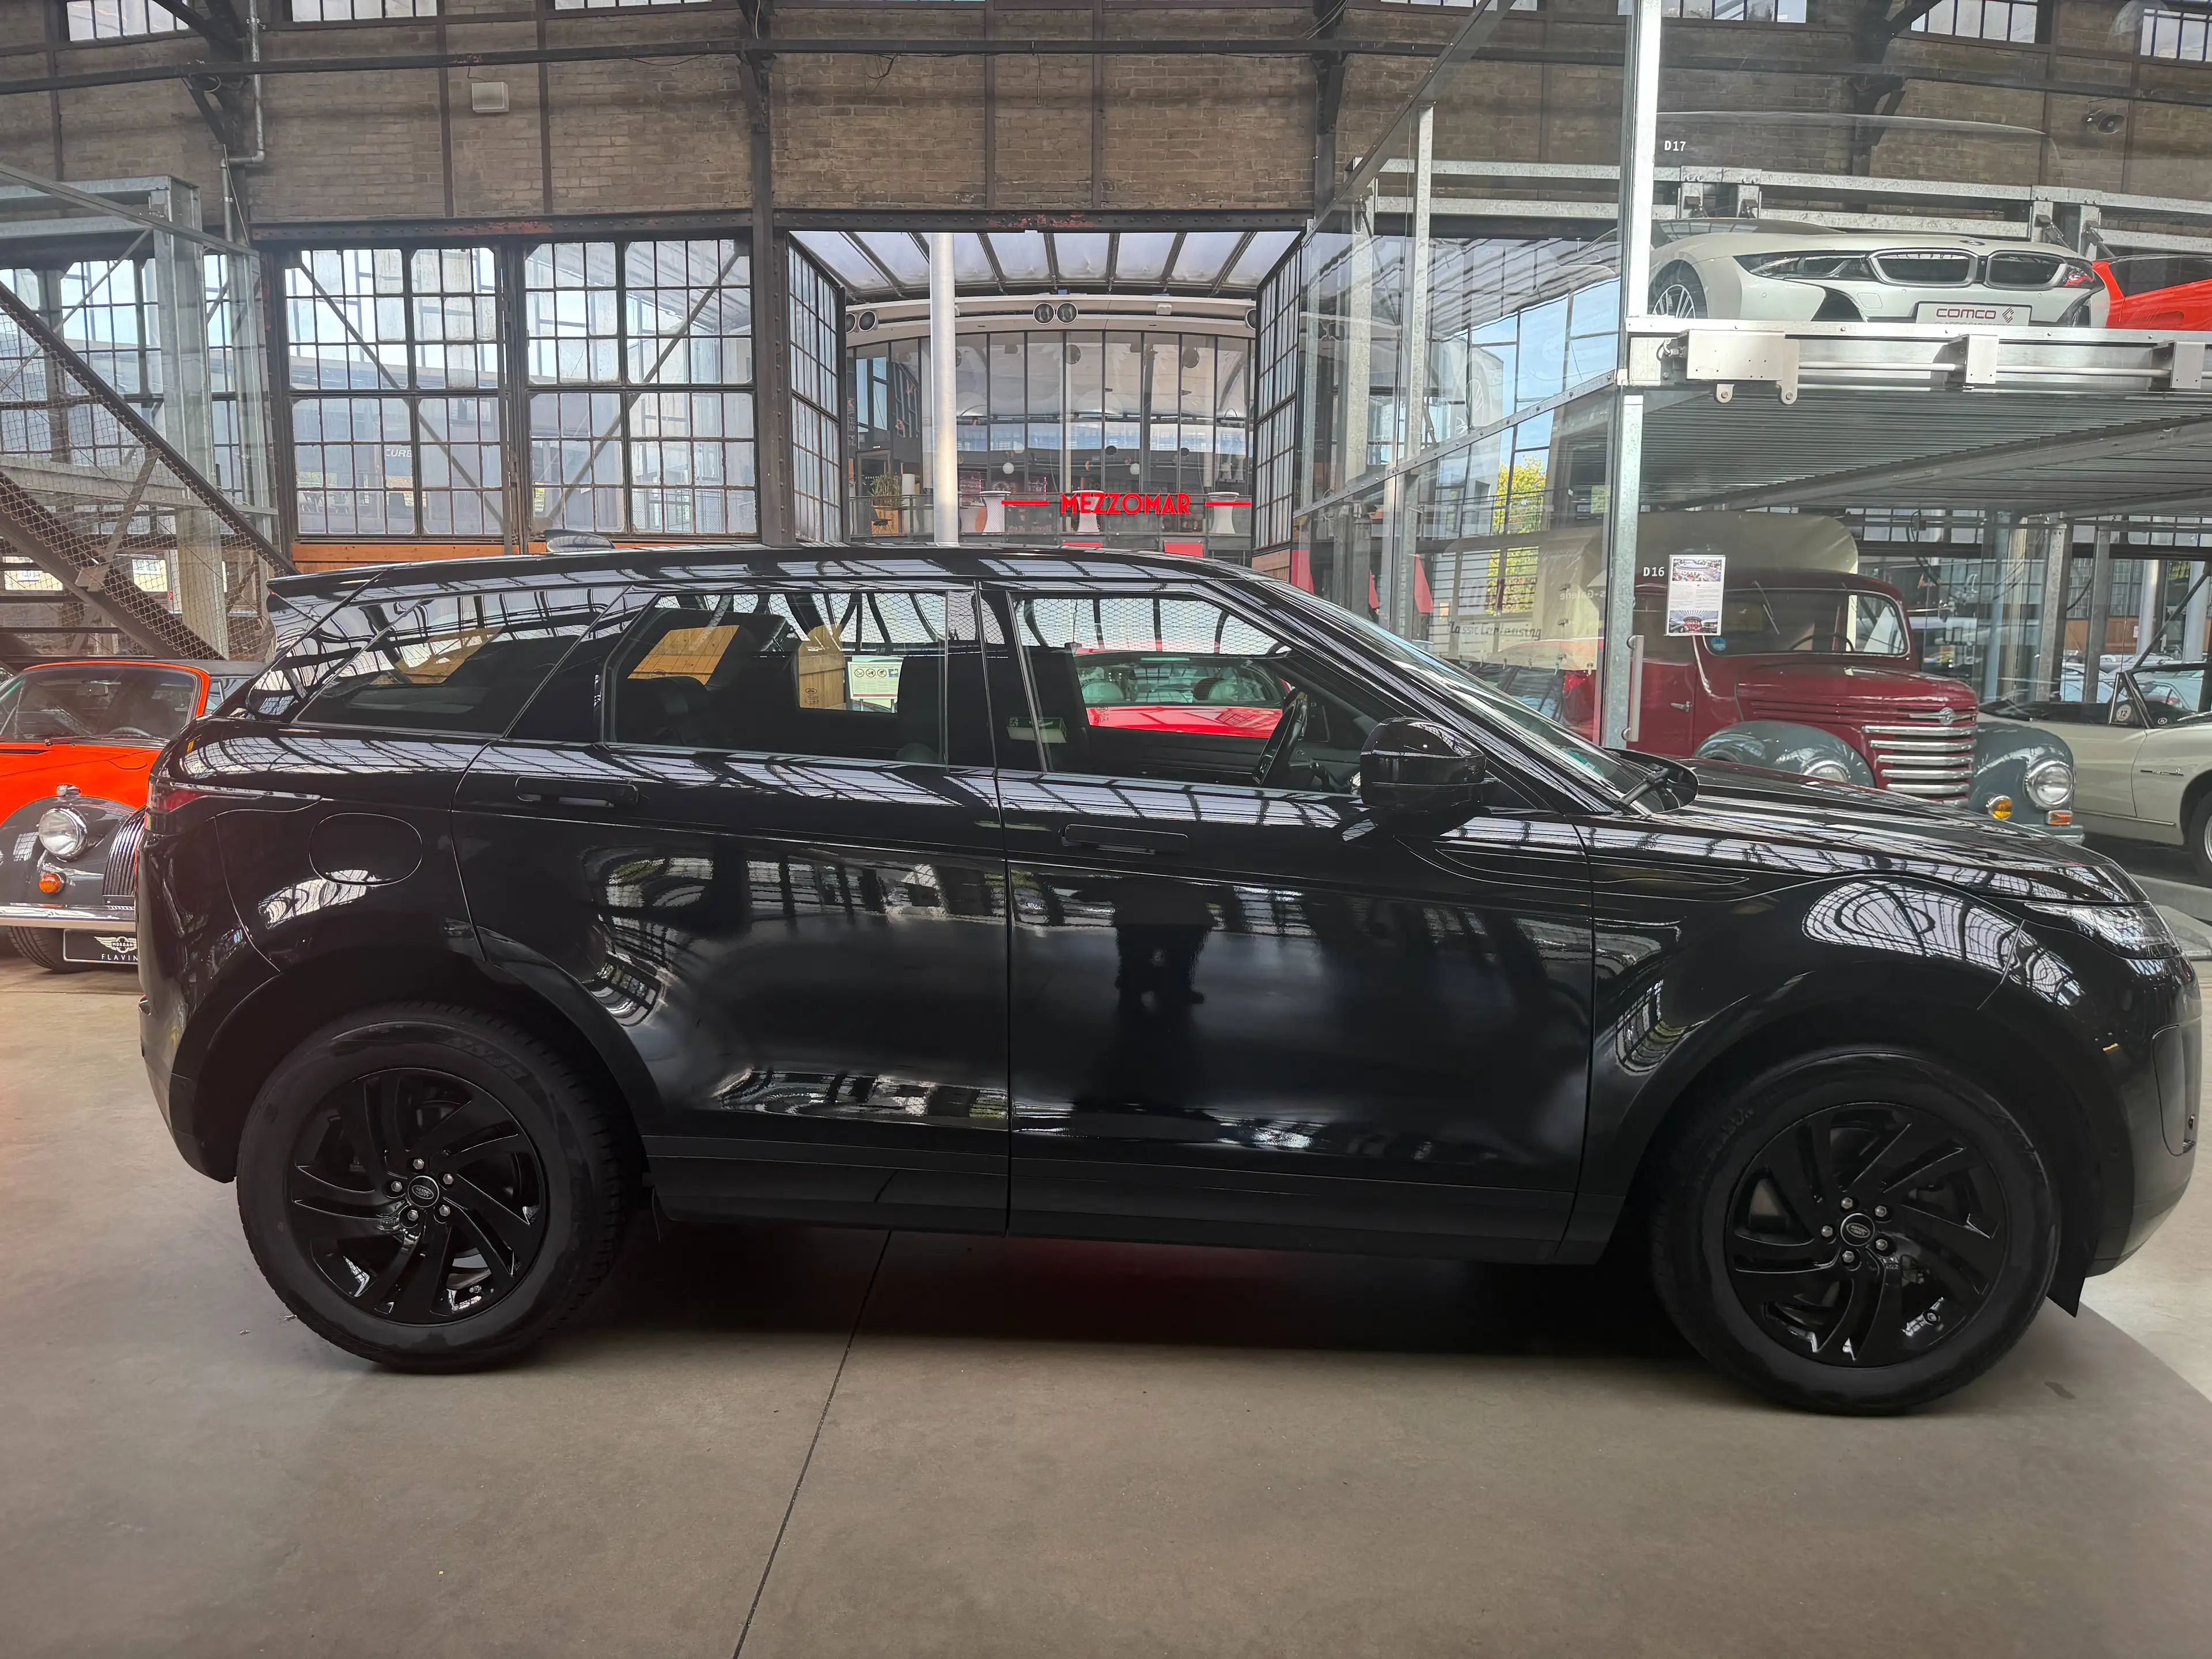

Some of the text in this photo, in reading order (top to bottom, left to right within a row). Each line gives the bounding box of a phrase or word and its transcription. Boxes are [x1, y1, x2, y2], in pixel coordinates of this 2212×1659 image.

[1664, 140, 1686, 151] D17
[1060, 493, 1191, 515] MEZZOMAR
[1643, 566, 1665, 577] D16
